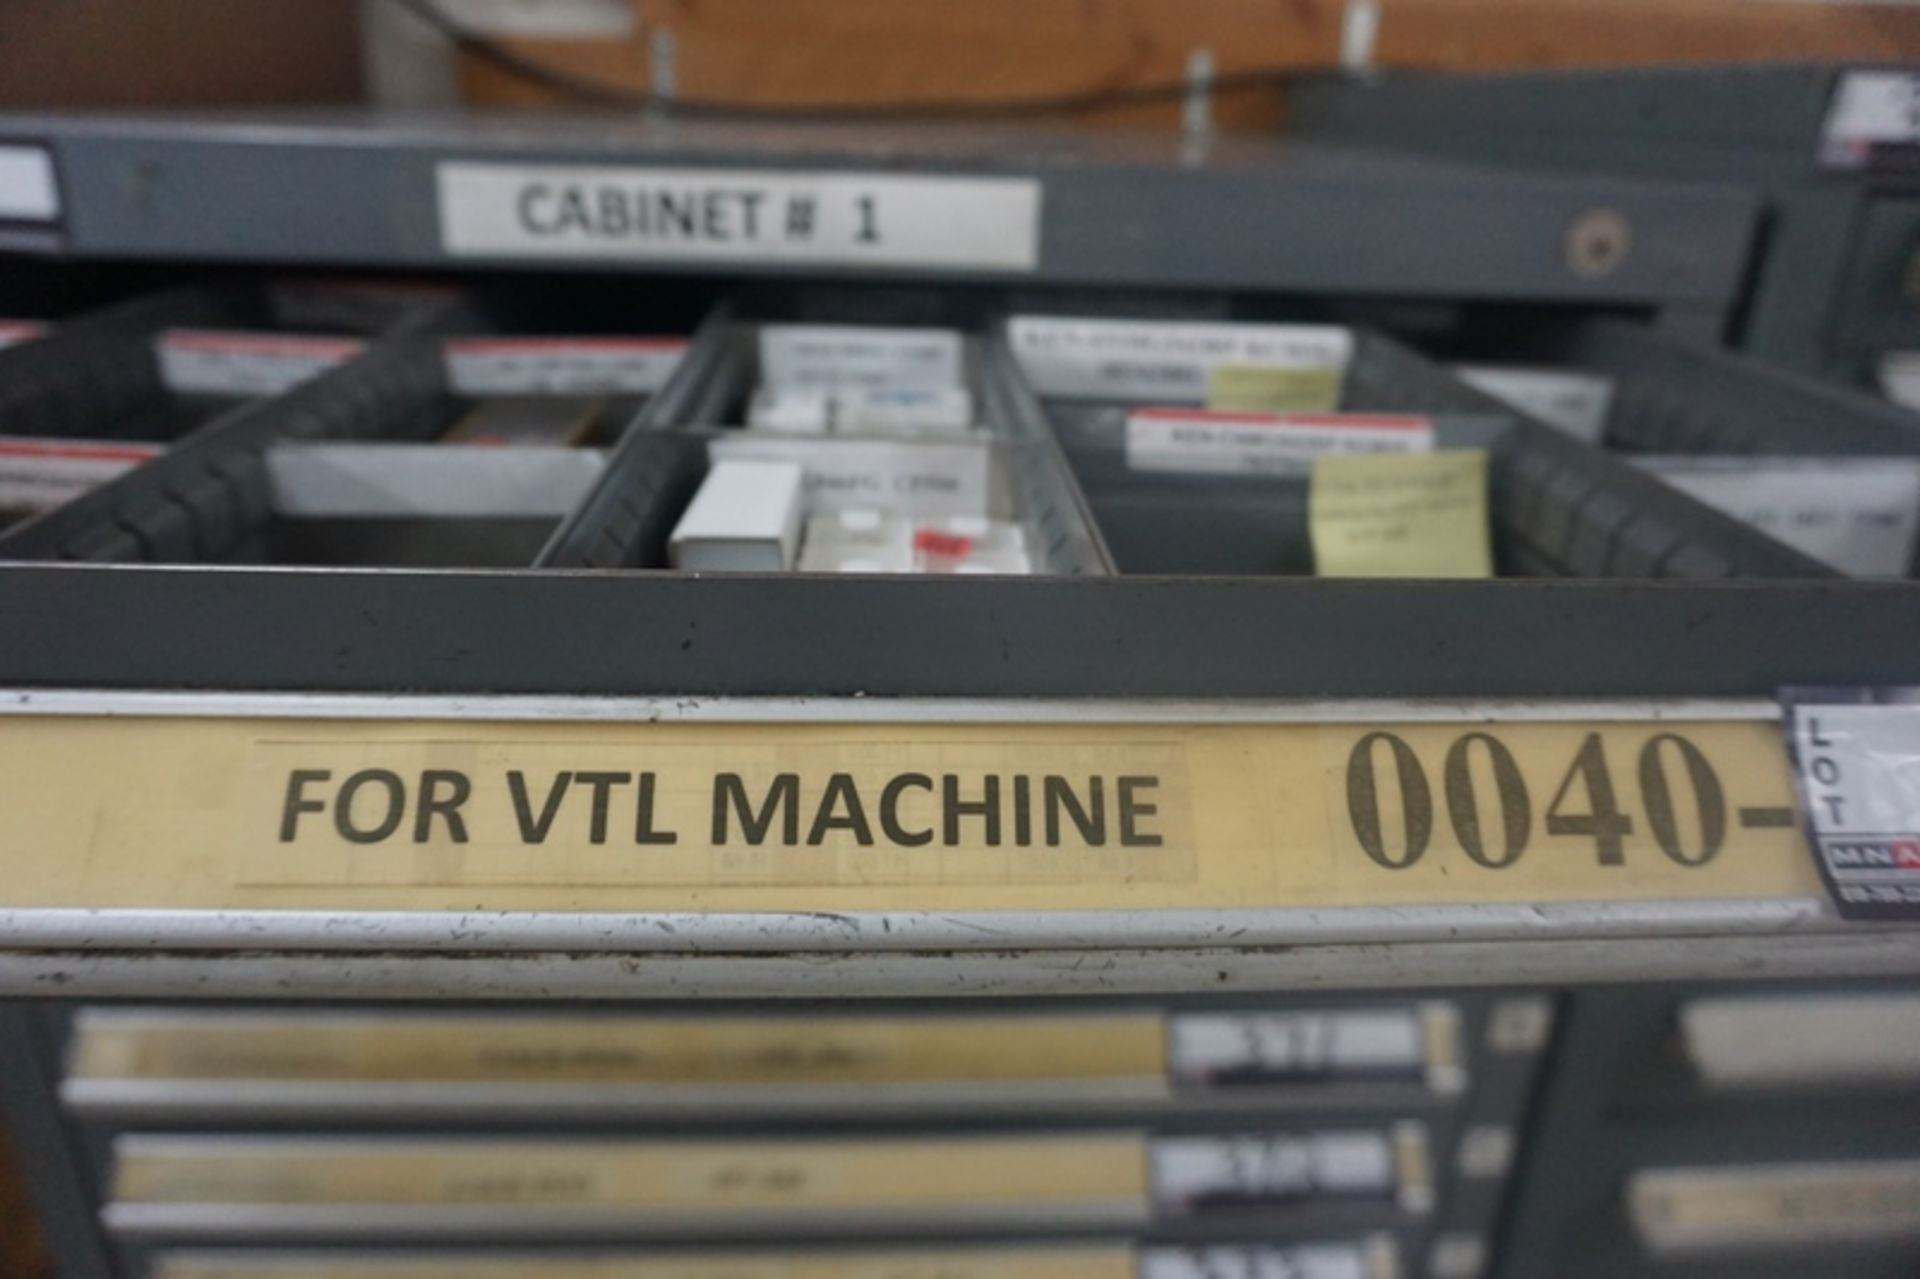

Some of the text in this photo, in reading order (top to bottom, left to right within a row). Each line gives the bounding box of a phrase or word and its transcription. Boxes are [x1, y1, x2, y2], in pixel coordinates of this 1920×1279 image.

[516, 183, 883, 244] CABINET # 1
[279, 768, 1164, 848] FOR VTL MACHINE
